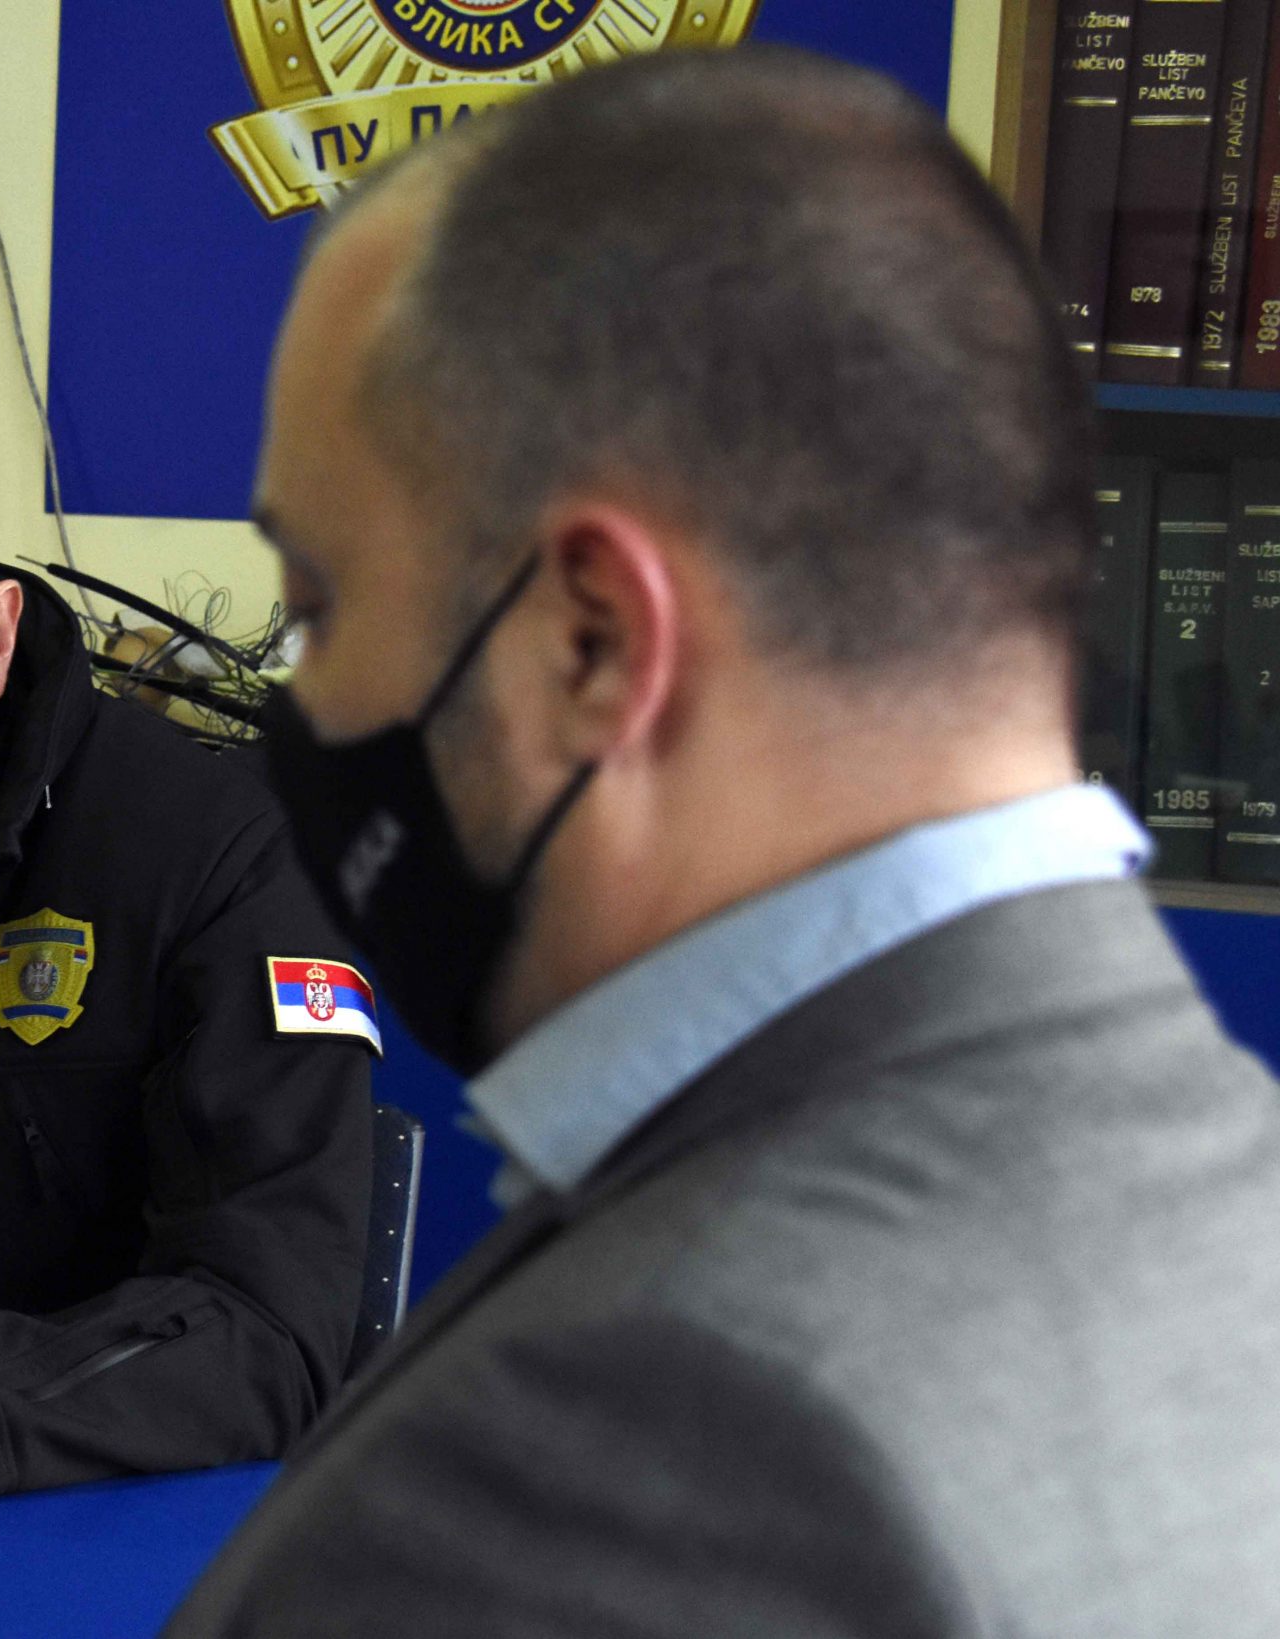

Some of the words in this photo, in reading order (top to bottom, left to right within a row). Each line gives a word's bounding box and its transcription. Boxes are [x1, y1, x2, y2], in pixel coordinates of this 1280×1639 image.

[1076, 35, 1113, 47] LIST
[1064, 54, 1126, 71] ANČEVO
[1158, 68, 1189, 80] LIST
[1138, 84, 1206, 101] PANČEVO
[1225, 78, 1248, 158] PANČEVA
[311, 118, 379, 171] ПУ
[1222, 174, 1238, 206] LIST
[1209, 217, 1232, 294] SLUŽBEN
[1131, 287, 1162, 302] 1978
[1171, 584, 1212, 597] LIST
[1180, 618, 1197, 639] 2
[1260, 670, 1270, 685] 2
[1153, 789, 1210, 810] 1985
[1242, 801, 1276, 817] 1979
